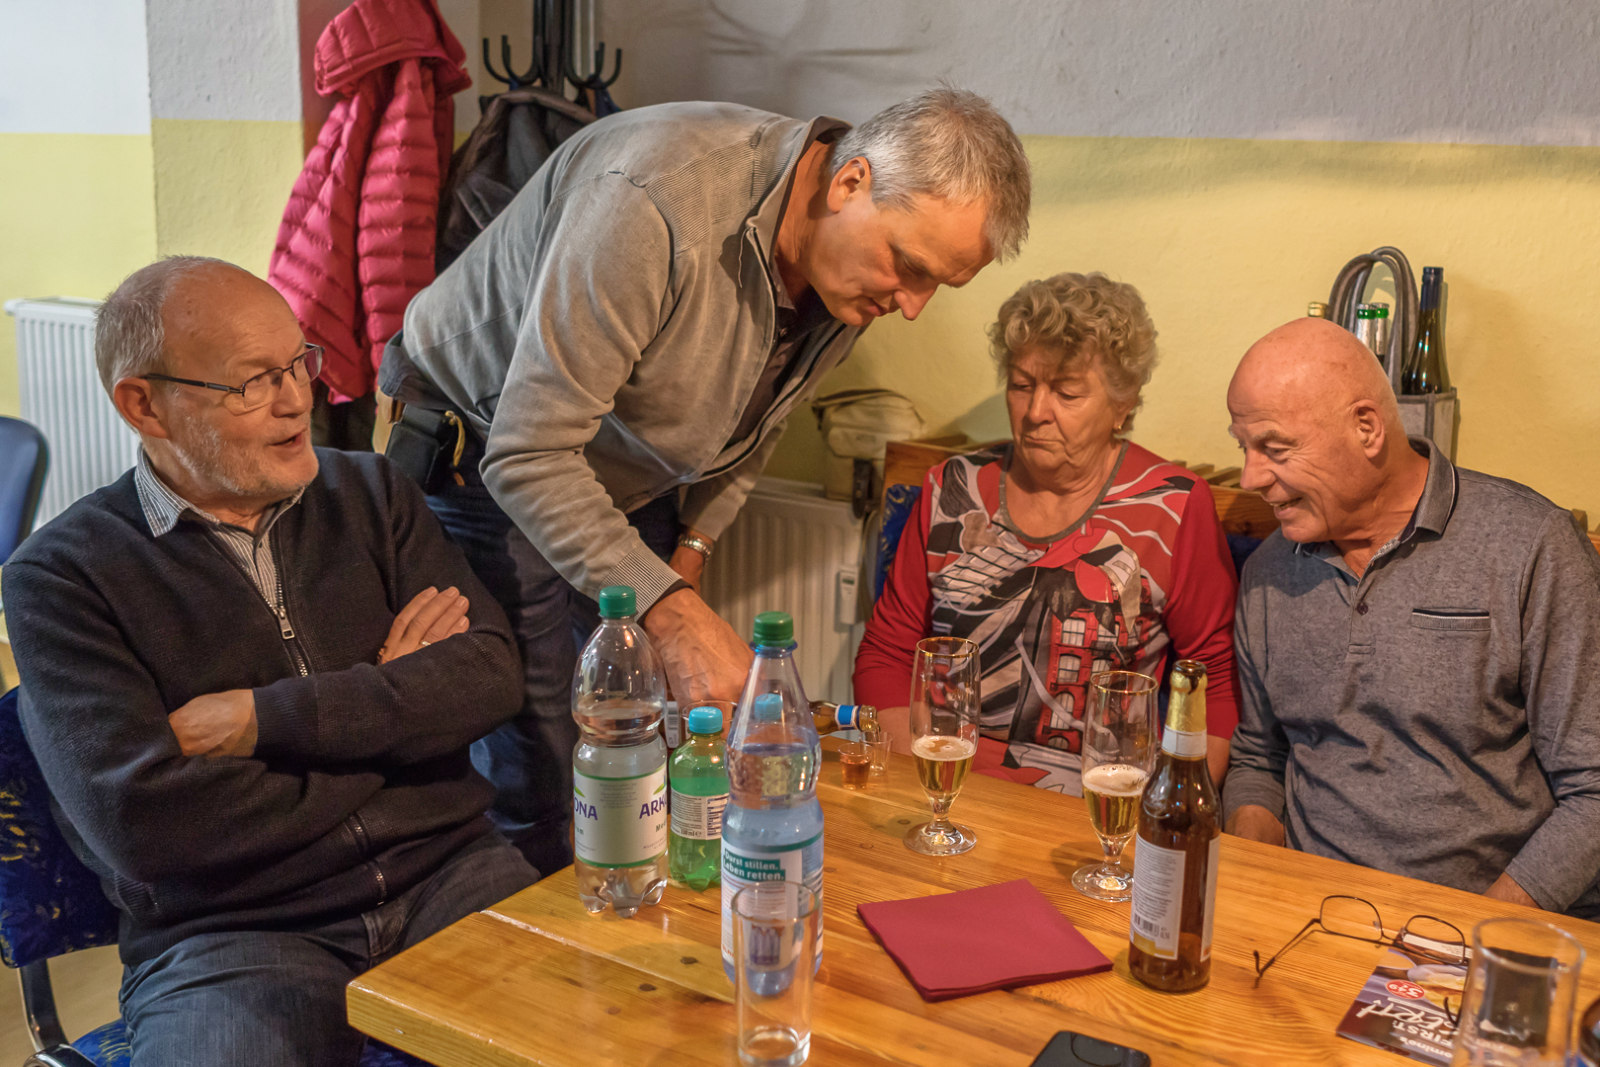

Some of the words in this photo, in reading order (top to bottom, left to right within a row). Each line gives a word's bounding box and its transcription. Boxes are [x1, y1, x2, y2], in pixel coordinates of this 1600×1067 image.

[639, 794, 667, 819] ARK
[723, 858, 745, 876] Leben
[747, 871, 784, 881] retten.
[725, 849, 743, 866] Durst
[744, 860, 778, 871] stillen.
[1399, 1036, 1453, 1058] omino's
